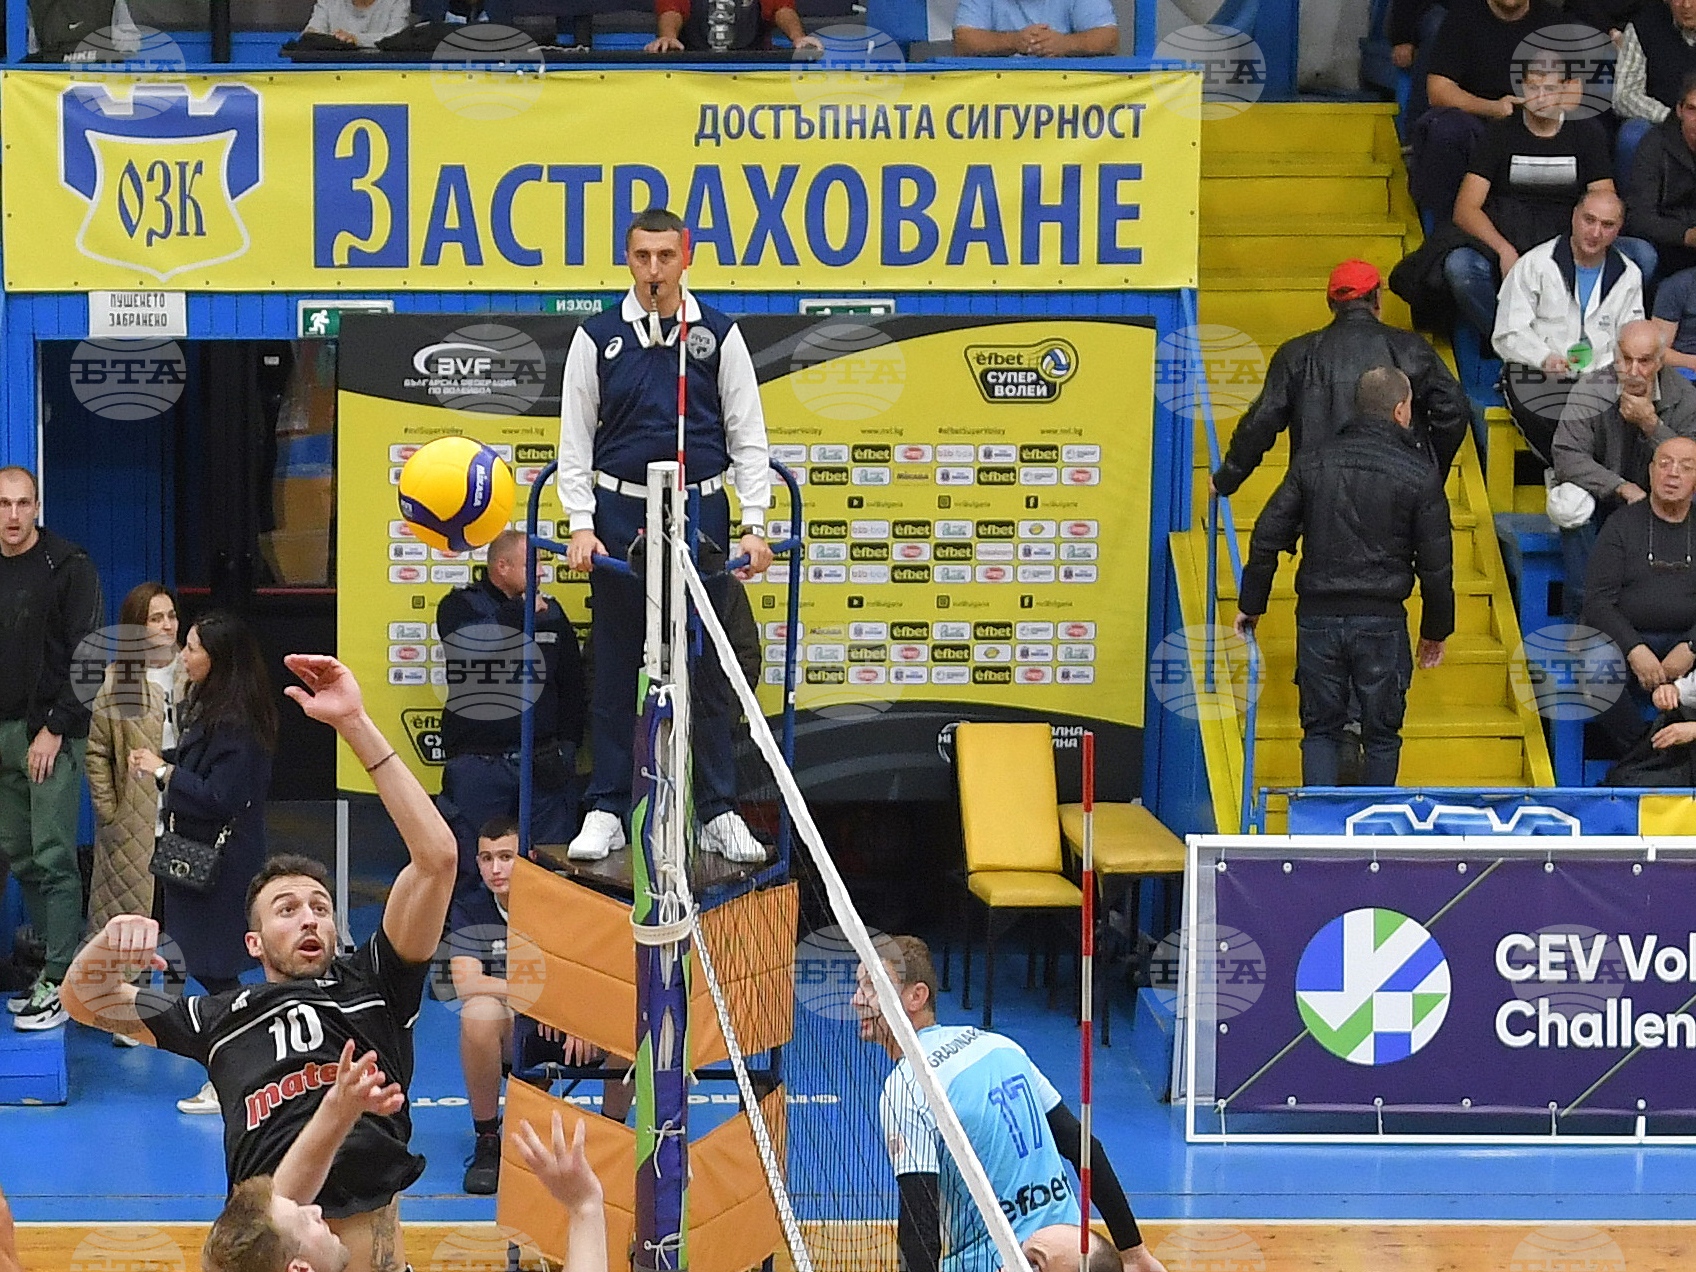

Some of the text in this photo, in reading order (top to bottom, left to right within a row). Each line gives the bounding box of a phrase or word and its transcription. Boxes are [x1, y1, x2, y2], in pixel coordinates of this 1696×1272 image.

[63, 50, 98, 62] NIKE
[695, 102, 1147, 147] ДОСТЪПНАТА СИГУРНОСТ
[117, 157, 207, 248] ОЗК
[108, 312, 168, 328] ЗАБРАНЕНО
[555, 298, 603, 313] ИЗХОД
[986, 371, 1038, 385] СУПЕР
[993, 380, 1048, 398] ВОЛЕЙ
[1495, 933, 1608, 982] CEV
[268, 1003, 324, 1062] 10
[1495, 997, 1696, 1048] Challen
[988, 1073, 1043, 1159] 17
[999, 1171, 1072, 1223] efbet
